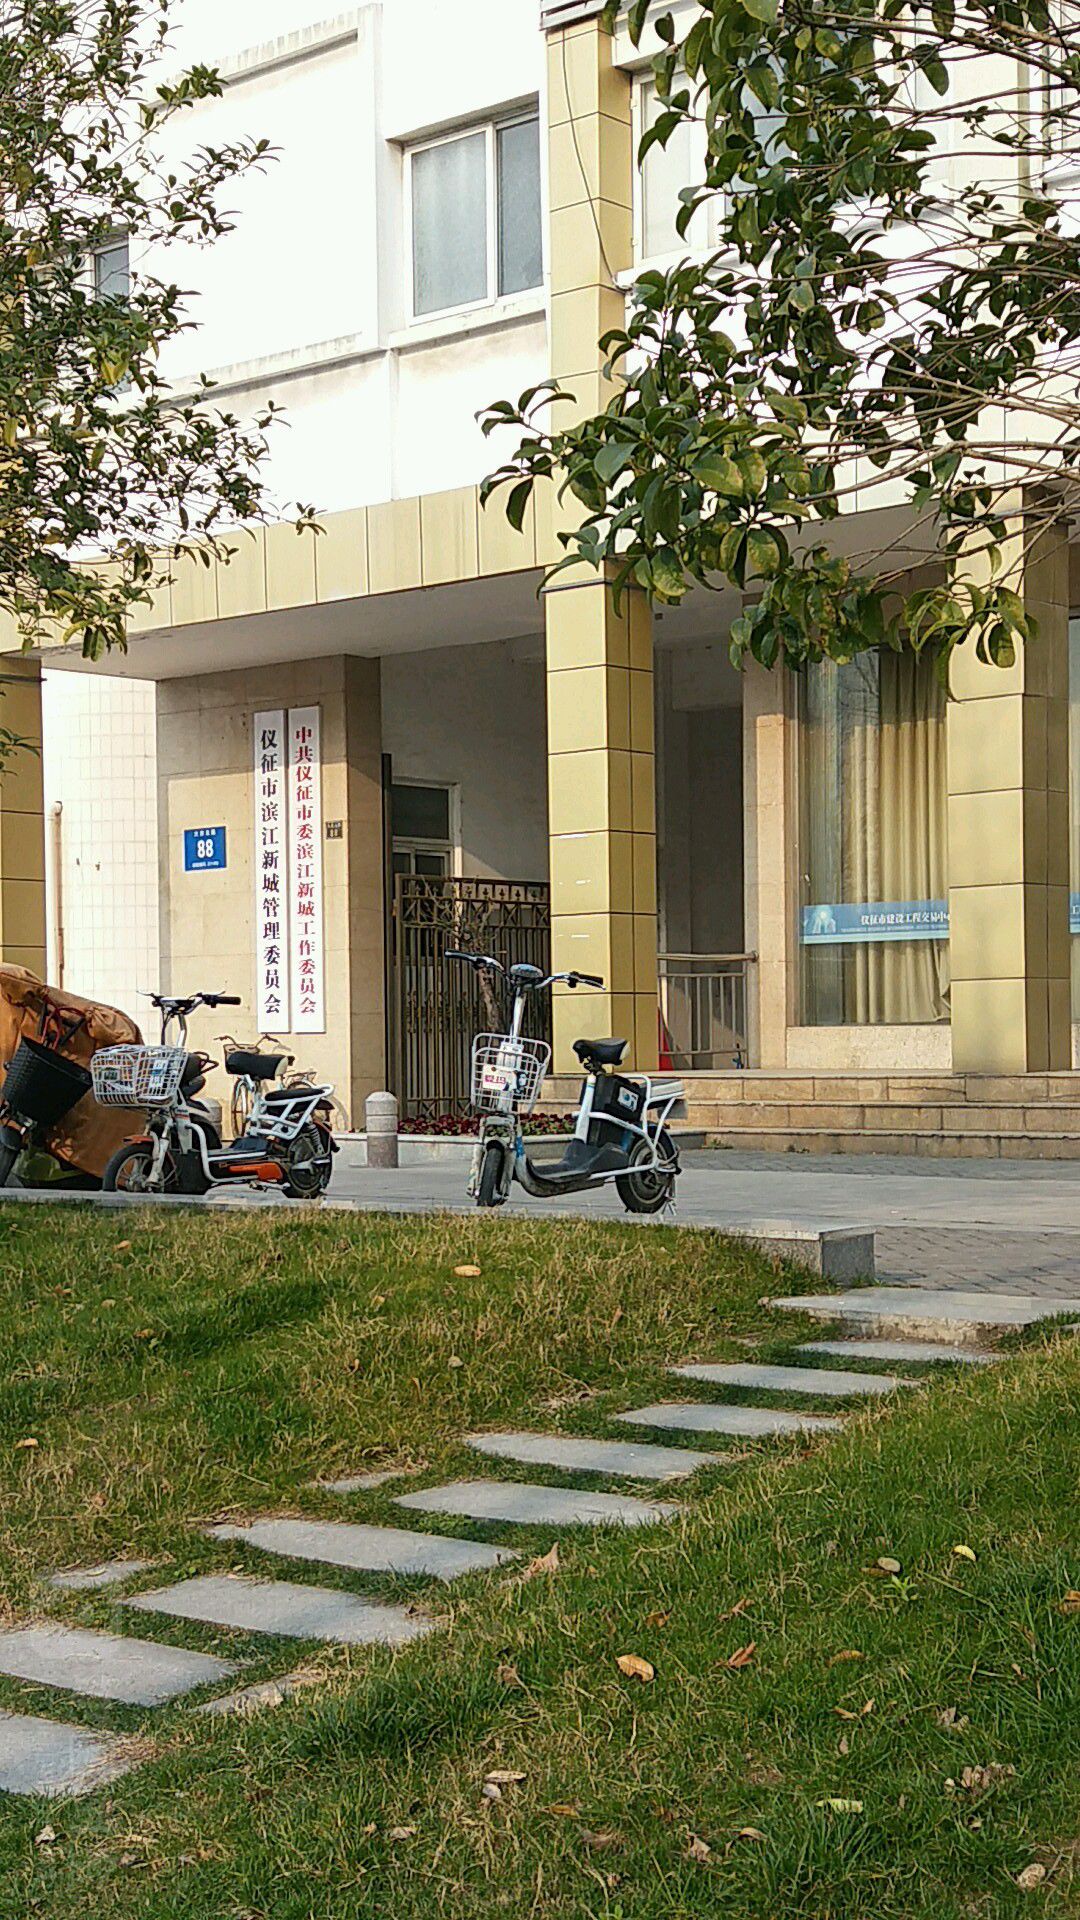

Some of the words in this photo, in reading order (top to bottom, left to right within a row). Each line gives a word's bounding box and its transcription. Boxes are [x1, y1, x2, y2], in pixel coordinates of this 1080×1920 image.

[197, 838, 214, 858] 88
[261, 729, 281, 1013] 仪征市滨江新城管理委员会
[295, 726, 316, 1013] 中共仪征市委滨江新城工作委员会
